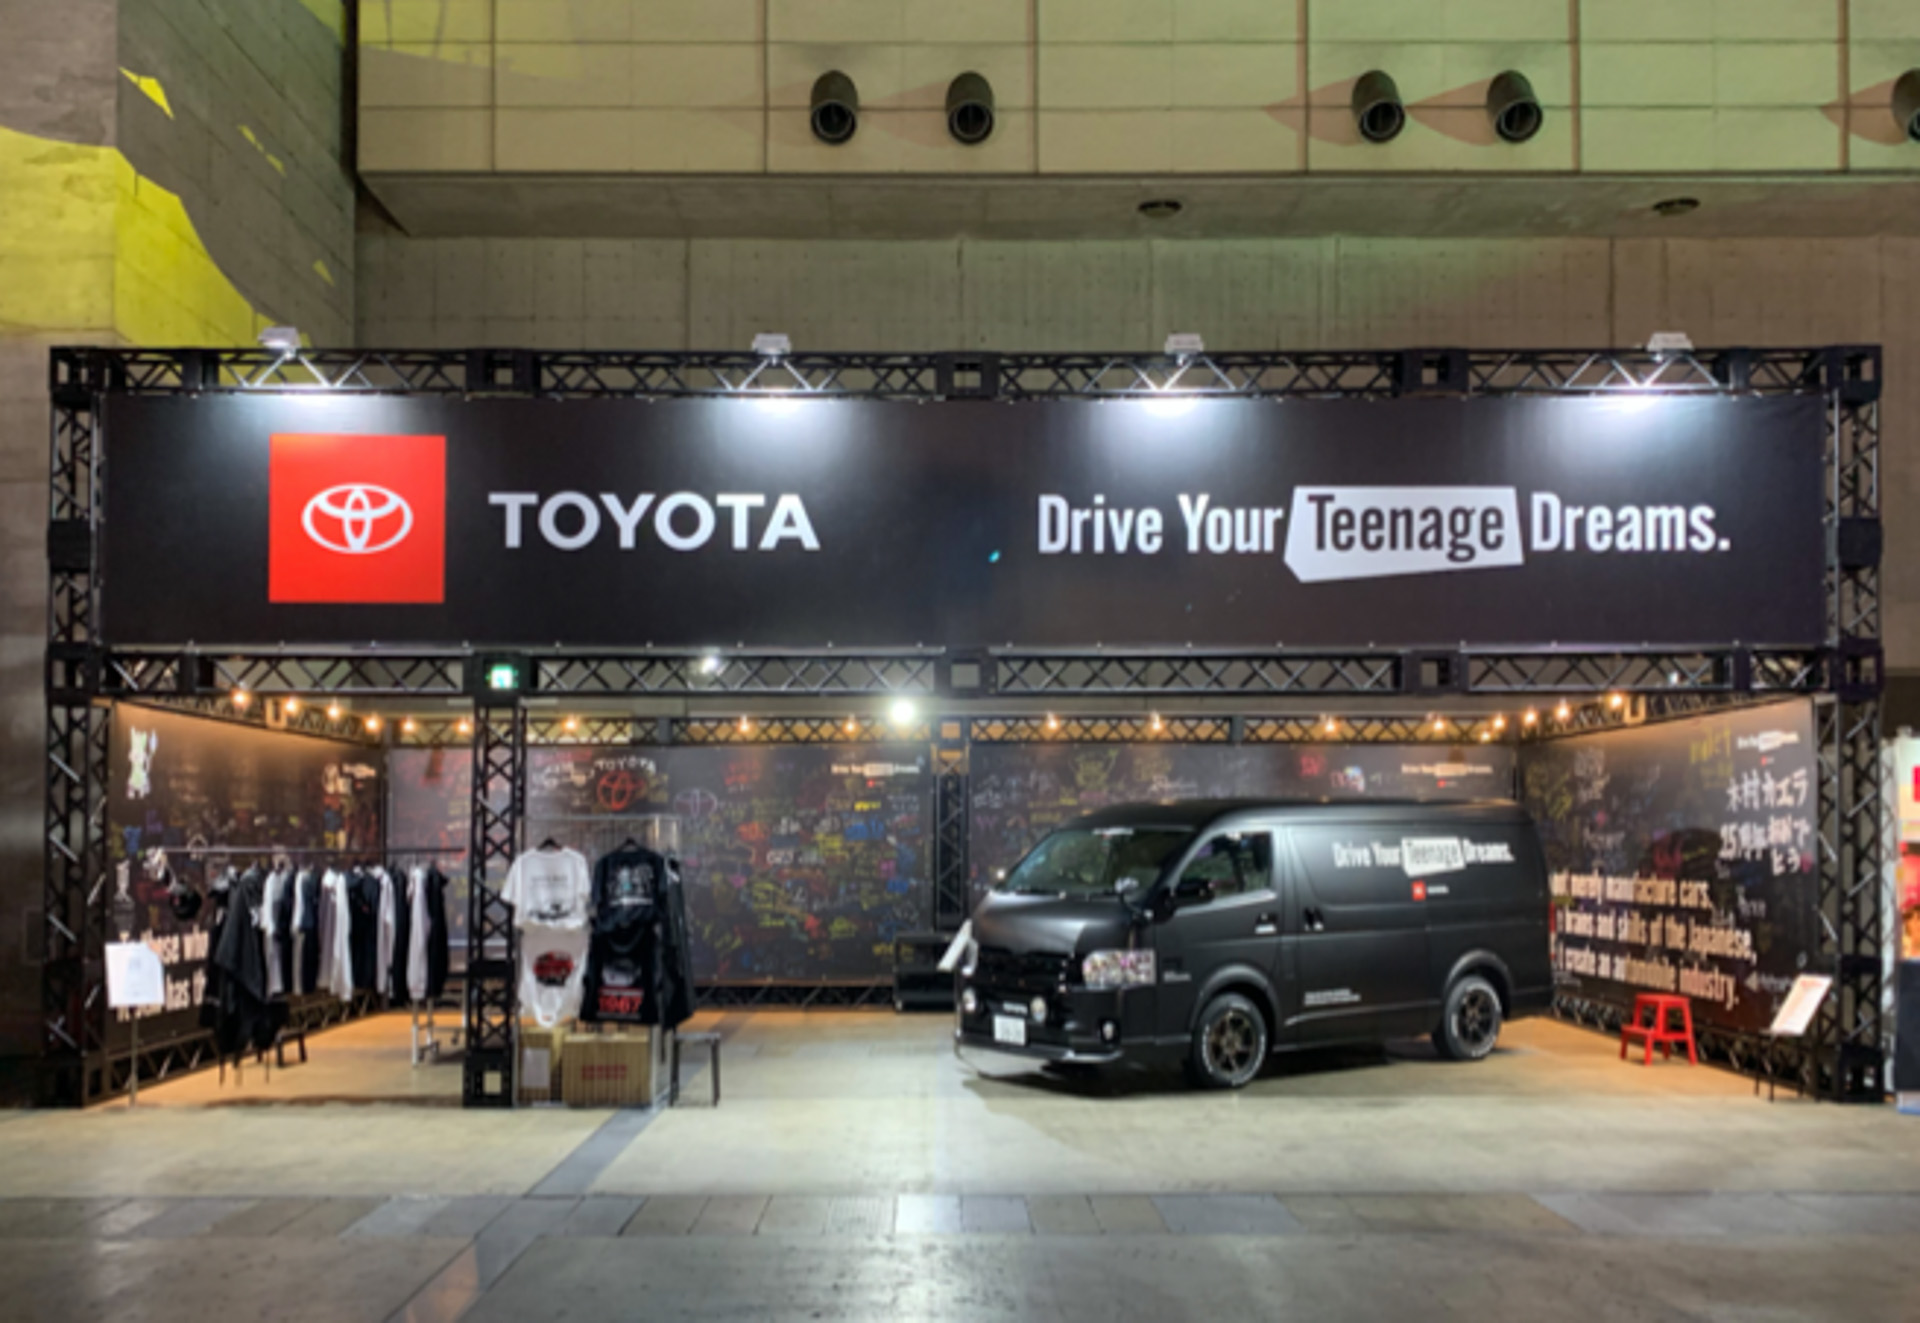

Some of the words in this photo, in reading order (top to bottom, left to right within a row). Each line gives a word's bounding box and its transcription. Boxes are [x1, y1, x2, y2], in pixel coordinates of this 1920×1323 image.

[488, 491, 820, 550] TOYOTA
[1038, 494, 1163, 554] Drive
[1177, 493, 1283, 554] Your
[1307, 494, 1505, 563] Teenage
[1531, 493, 1730, 551] Dreams.
